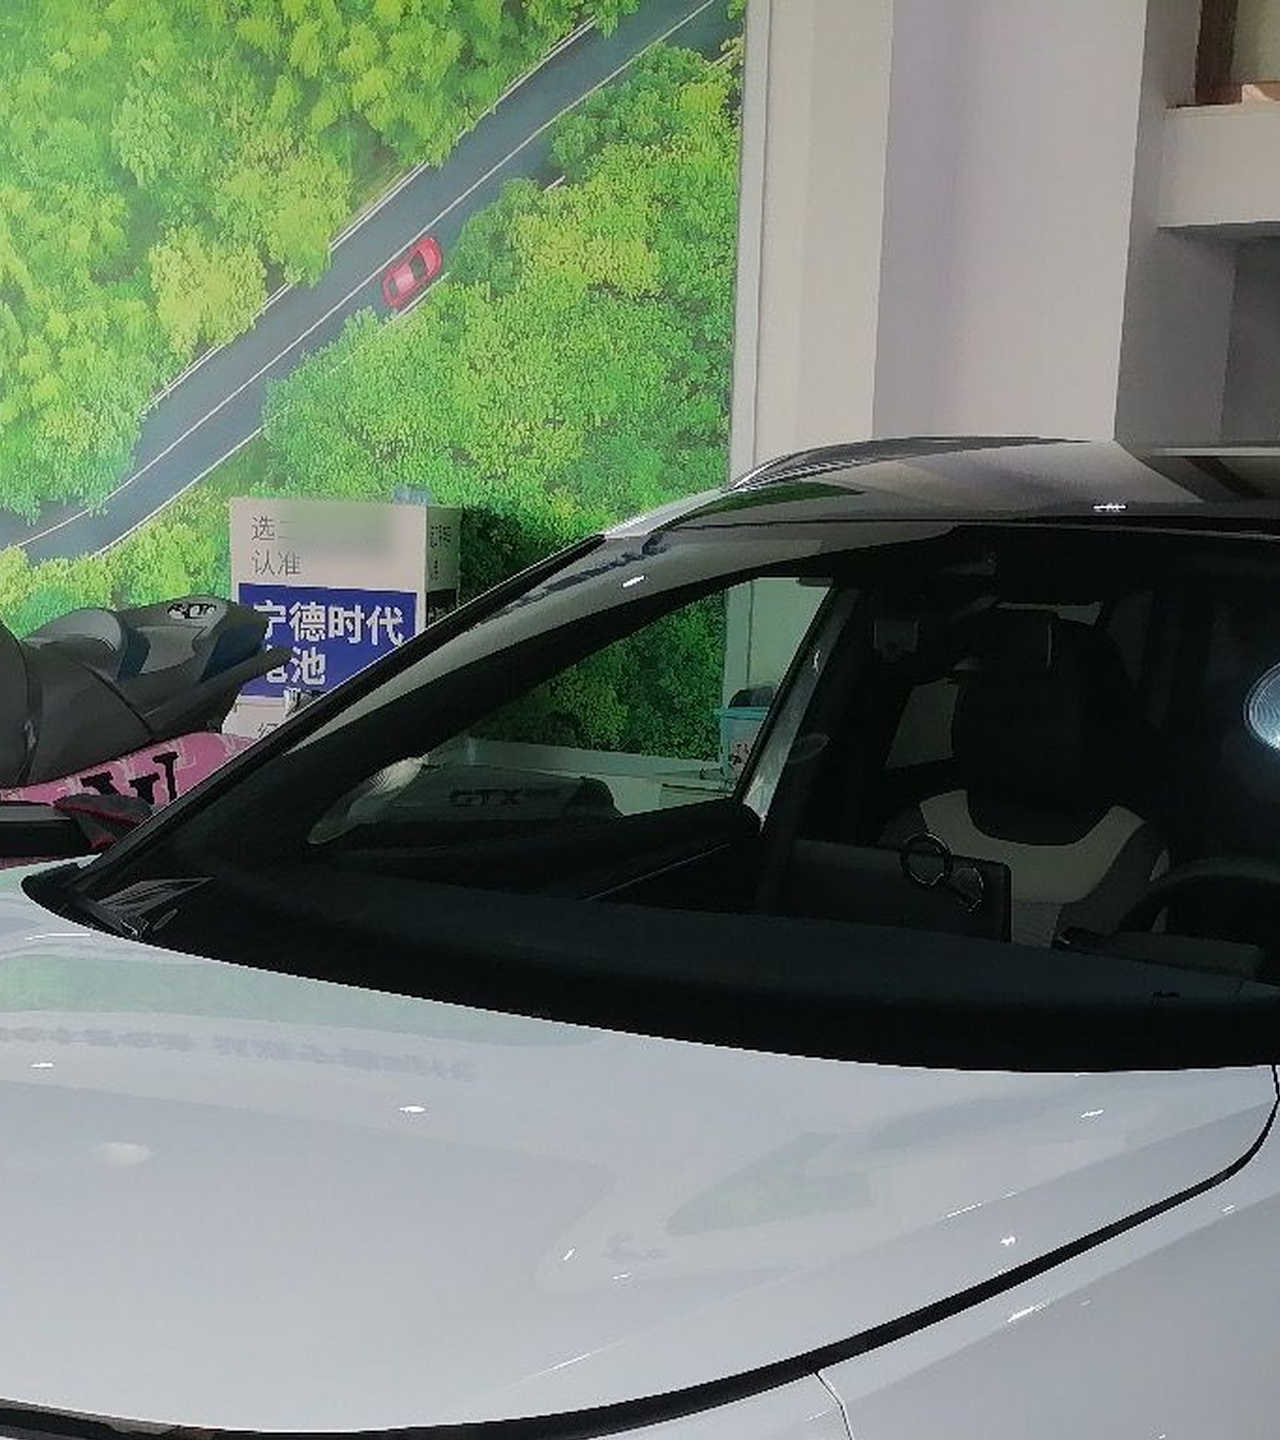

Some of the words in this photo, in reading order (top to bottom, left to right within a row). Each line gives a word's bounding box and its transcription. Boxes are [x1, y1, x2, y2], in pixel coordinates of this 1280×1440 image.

[251, 549, 301, 576] 认准
[253, 599, 407, 648] 宁德时代
